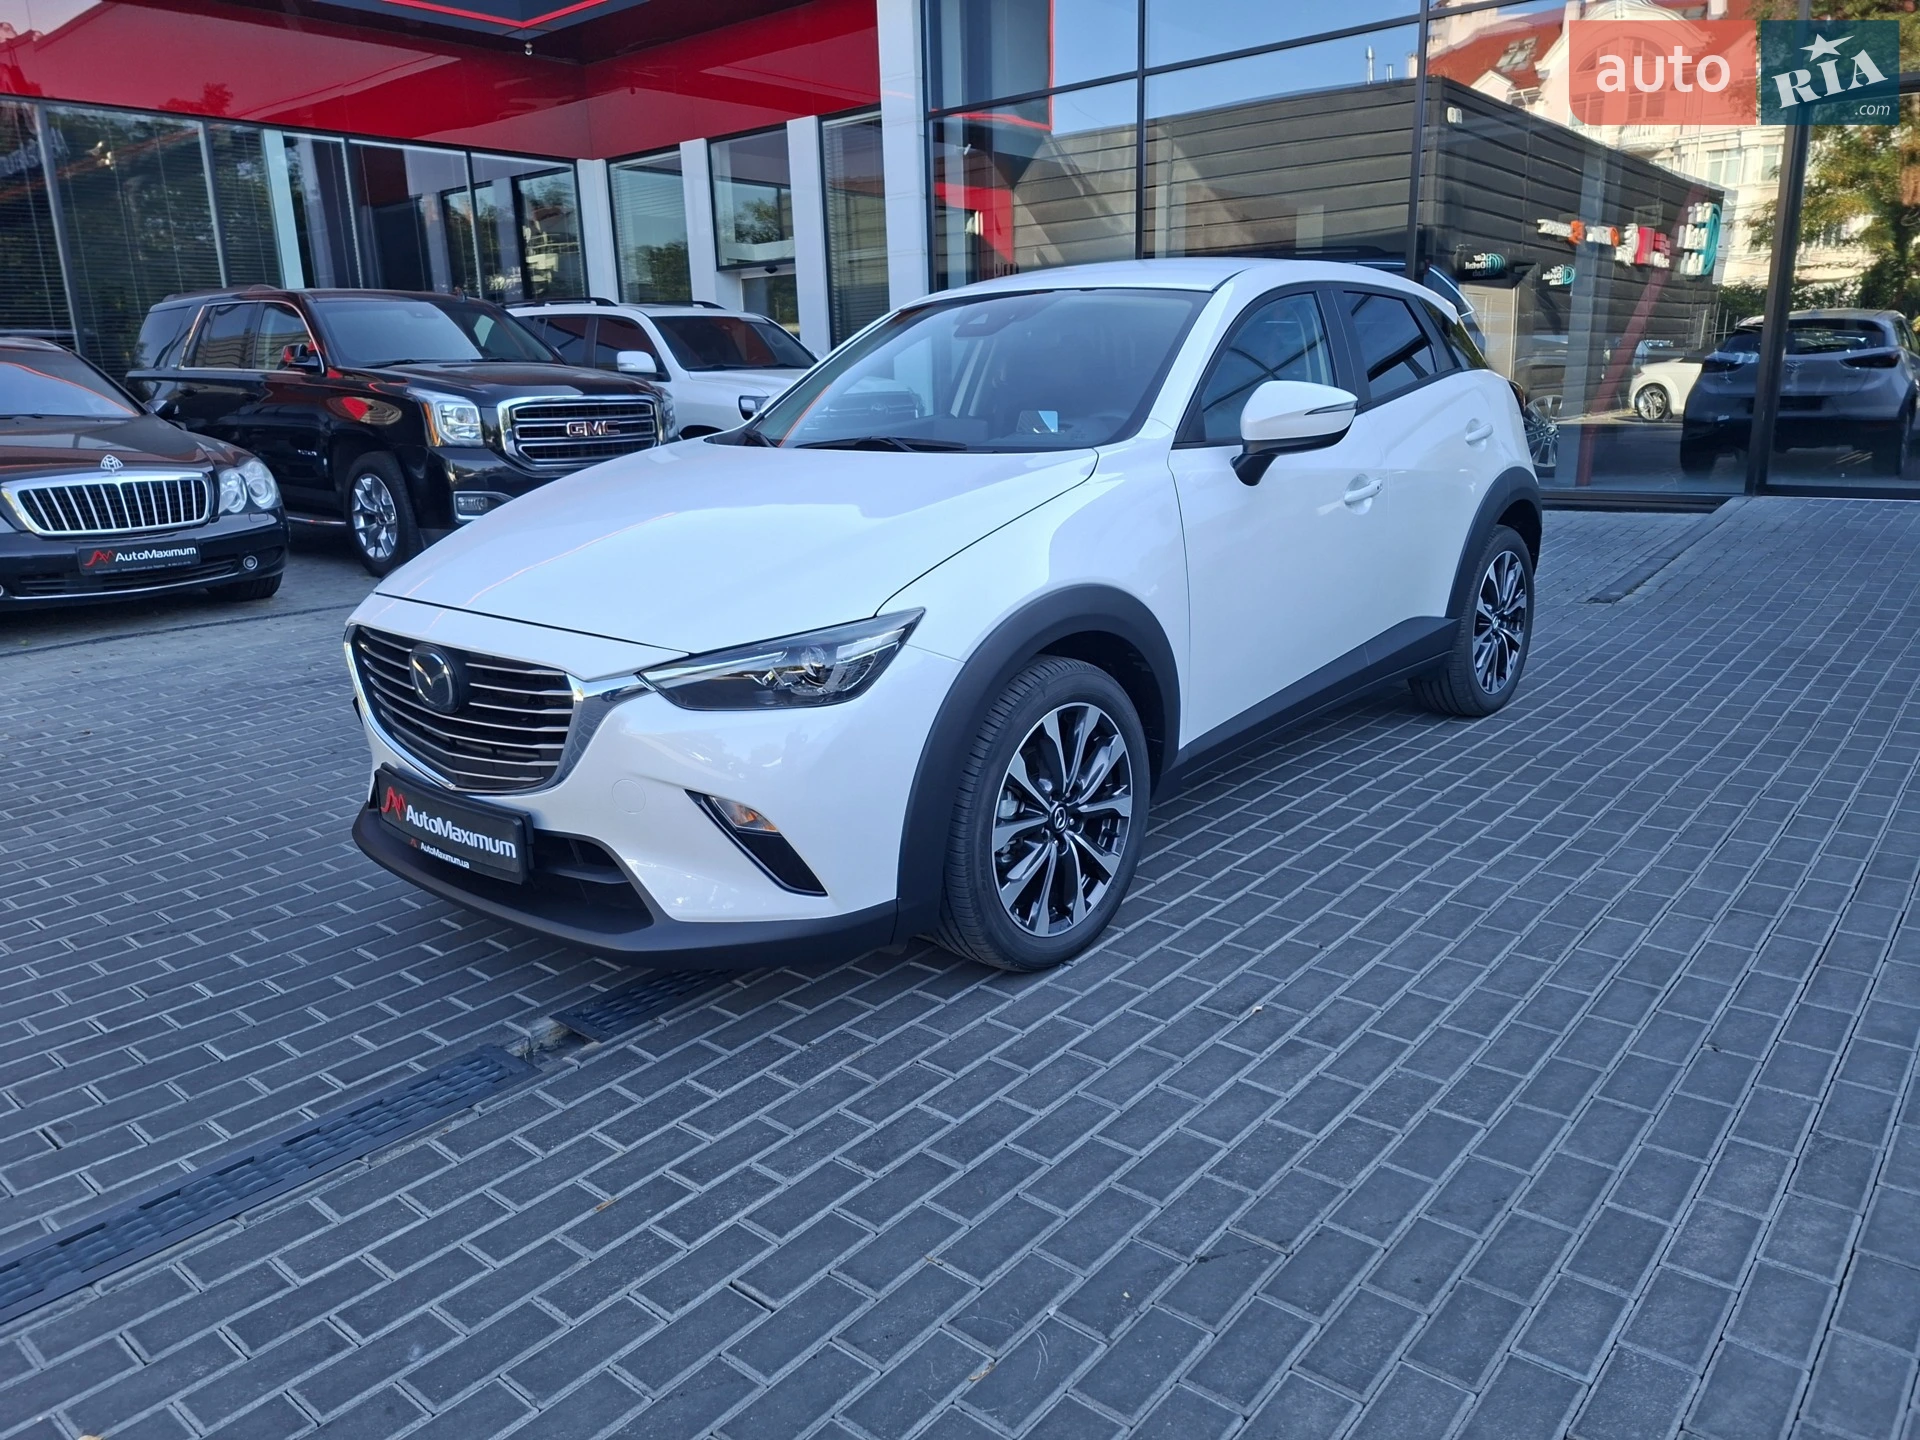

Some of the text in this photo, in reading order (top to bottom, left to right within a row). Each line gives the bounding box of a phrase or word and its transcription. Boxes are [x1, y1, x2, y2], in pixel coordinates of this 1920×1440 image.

[566, 420, 621, 437] GMC
[115, 547, 197, 562] AutoMaximum
[406, 805, 517, 858] AutoMaximum
[420, 842, 471, 869] AutoMaximum.ua
